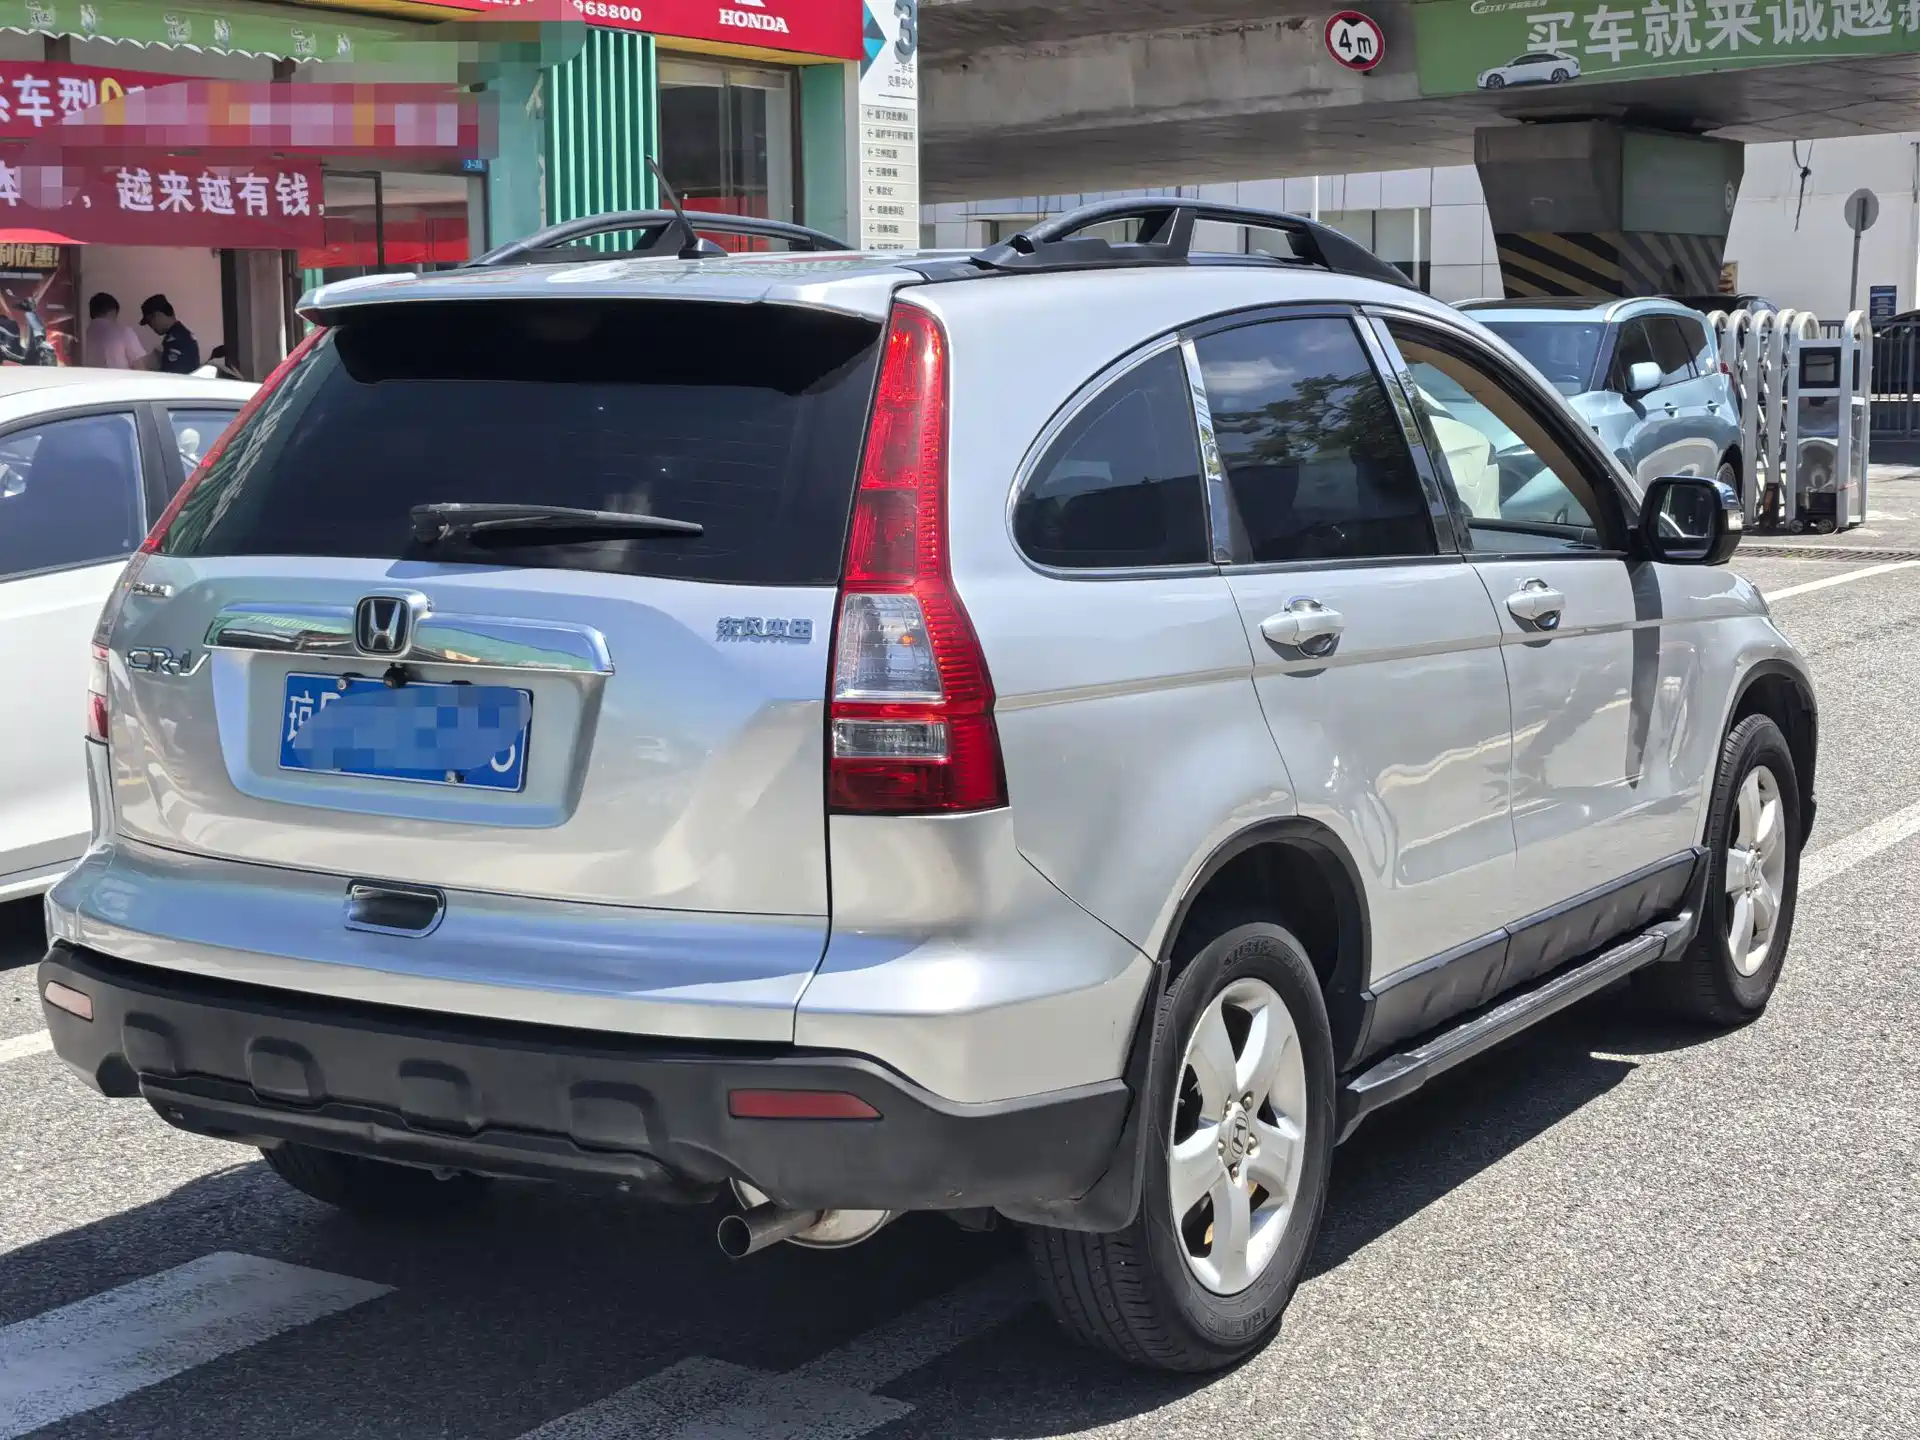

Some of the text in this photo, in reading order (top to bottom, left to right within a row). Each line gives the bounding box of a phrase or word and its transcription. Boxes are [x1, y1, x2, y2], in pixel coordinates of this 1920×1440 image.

[719, 8, 789, 33] HONDA
[894, 0, 918, 64] 3
[716, 616, 813, 644] 东风本田
[125, 647, 212, 677] CR-V
